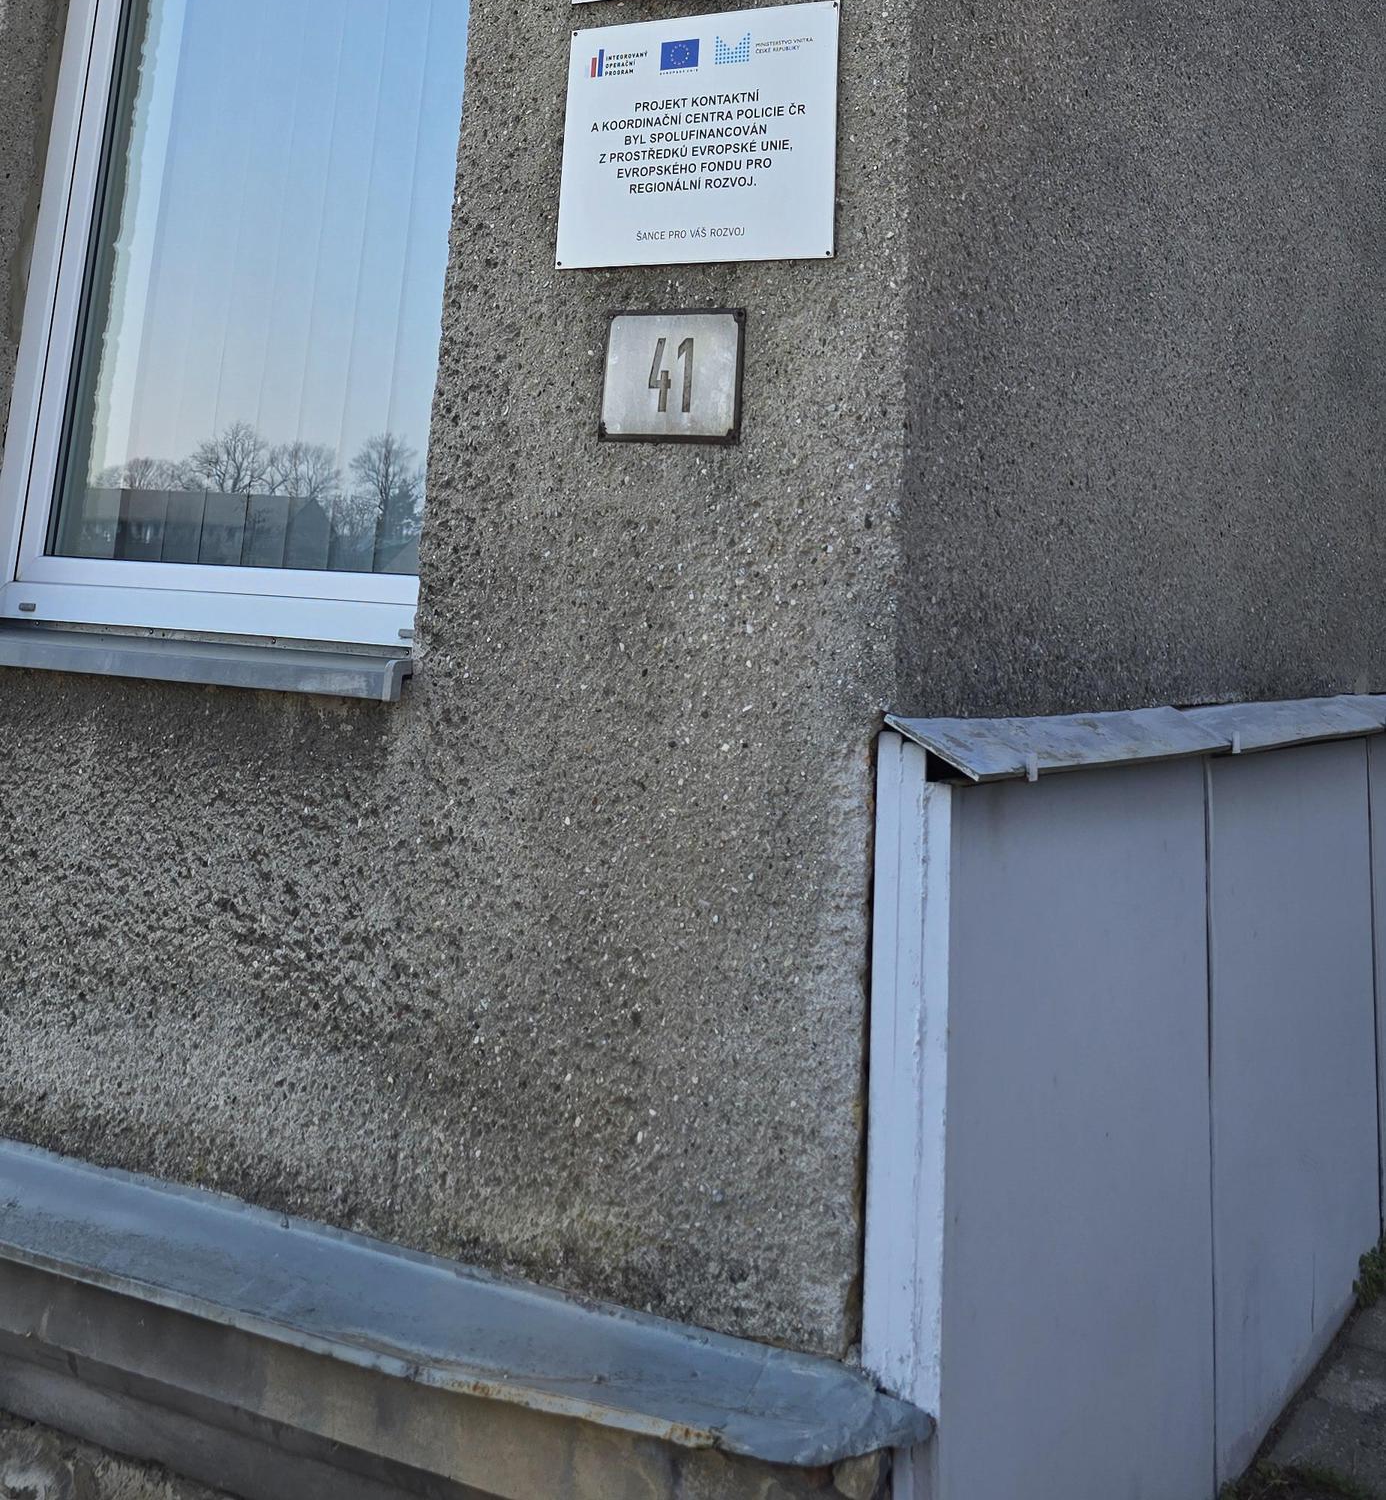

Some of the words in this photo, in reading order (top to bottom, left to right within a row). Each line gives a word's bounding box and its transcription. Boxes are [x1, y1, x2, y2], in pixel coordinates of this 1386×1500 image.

[755, 39, 792, 47] MINISTERSTVO
[604, 69, 634, 77] PROGRAM
[605, 59, 636, 69] OPERAČNÍ
[634, 98, 688, 112] PROJEKT
[691, 89, 760, 107] KONTAKTNÍ
[591, 122, 599, 132] A
[602, 112, 682, 132] KOORDINAČNÍ
[685, 110, 733, 124] CENTRA
[737, 106, 785, 120] POLICIE
[789, 102, 806, 115] ČR
[624, 134, 646, 146] BYL
[649, 124, 767, 144] SPOLUFINANCOVÁN
[599, 153, 607, 164] Z
[691, 140, 757, 157] EVROPSKÉ
[761, 139, 793, 152] UNIE,
[617, 161, 697, 179] EVROPSKÉHO
[700, 160, 742, 173] FONDU
[746, 157, 772, 170] PRO
[629, 176, 701, 194] REGIONÁLNÍ
[704, 176, 757, 190] ROZVOJ.
[636, 230, 666, 242] ŠANCE
[668, 230, 687, 240] PRO
[689, 227, 707, 238] VÁŠ
[710, 226, 745, 238] ROZVOJ
[648, 338, 694, 412] 41
